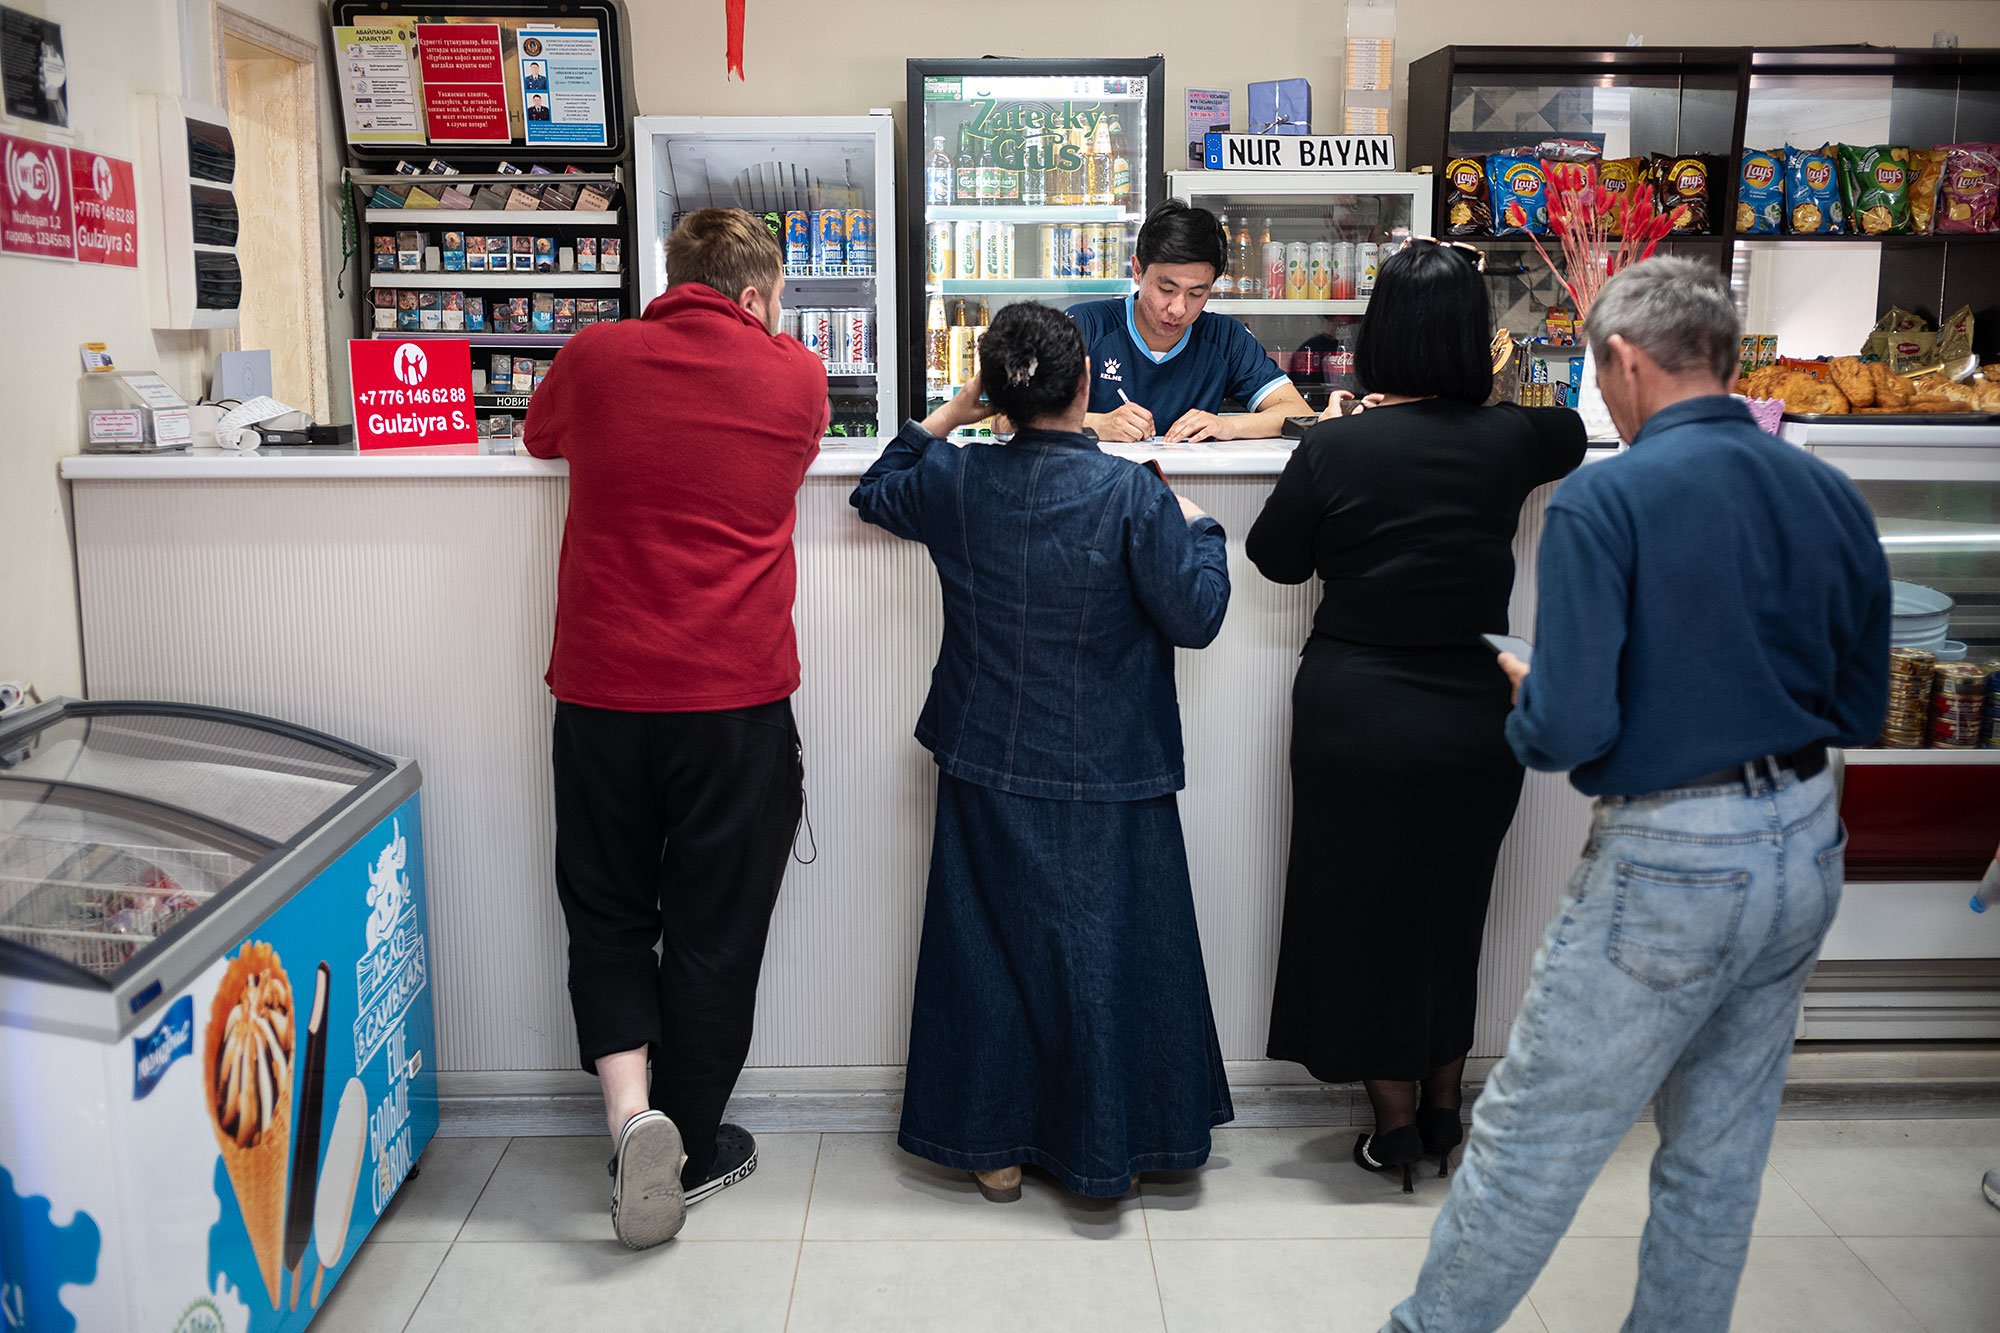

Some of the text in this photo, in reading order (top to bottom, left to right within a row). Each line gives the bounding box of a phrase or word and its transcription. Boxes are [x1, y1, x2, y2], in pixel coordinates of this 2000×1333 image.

[1210, 155, 1218, 163] D
[1229, 138, 1388, 166] NUR BAYAN
[78, 225, 135, 255] Gulziyra S.
[818, 318, 829, 361] TASSAY
[852, 318, 863, 363] TASSAY
[360, 388, 466, 405] +7 776 146 62 88
[368, 410, 470, 437] Gulziyra S.
[371, 928, 405, 992] ДЕЛО
[366, 951, 423, 1047] СЛИВКАХ
[370, 1071, 411, 1163] БОЛЬШЕ
[723, 1154, 758, 1186] crocs
